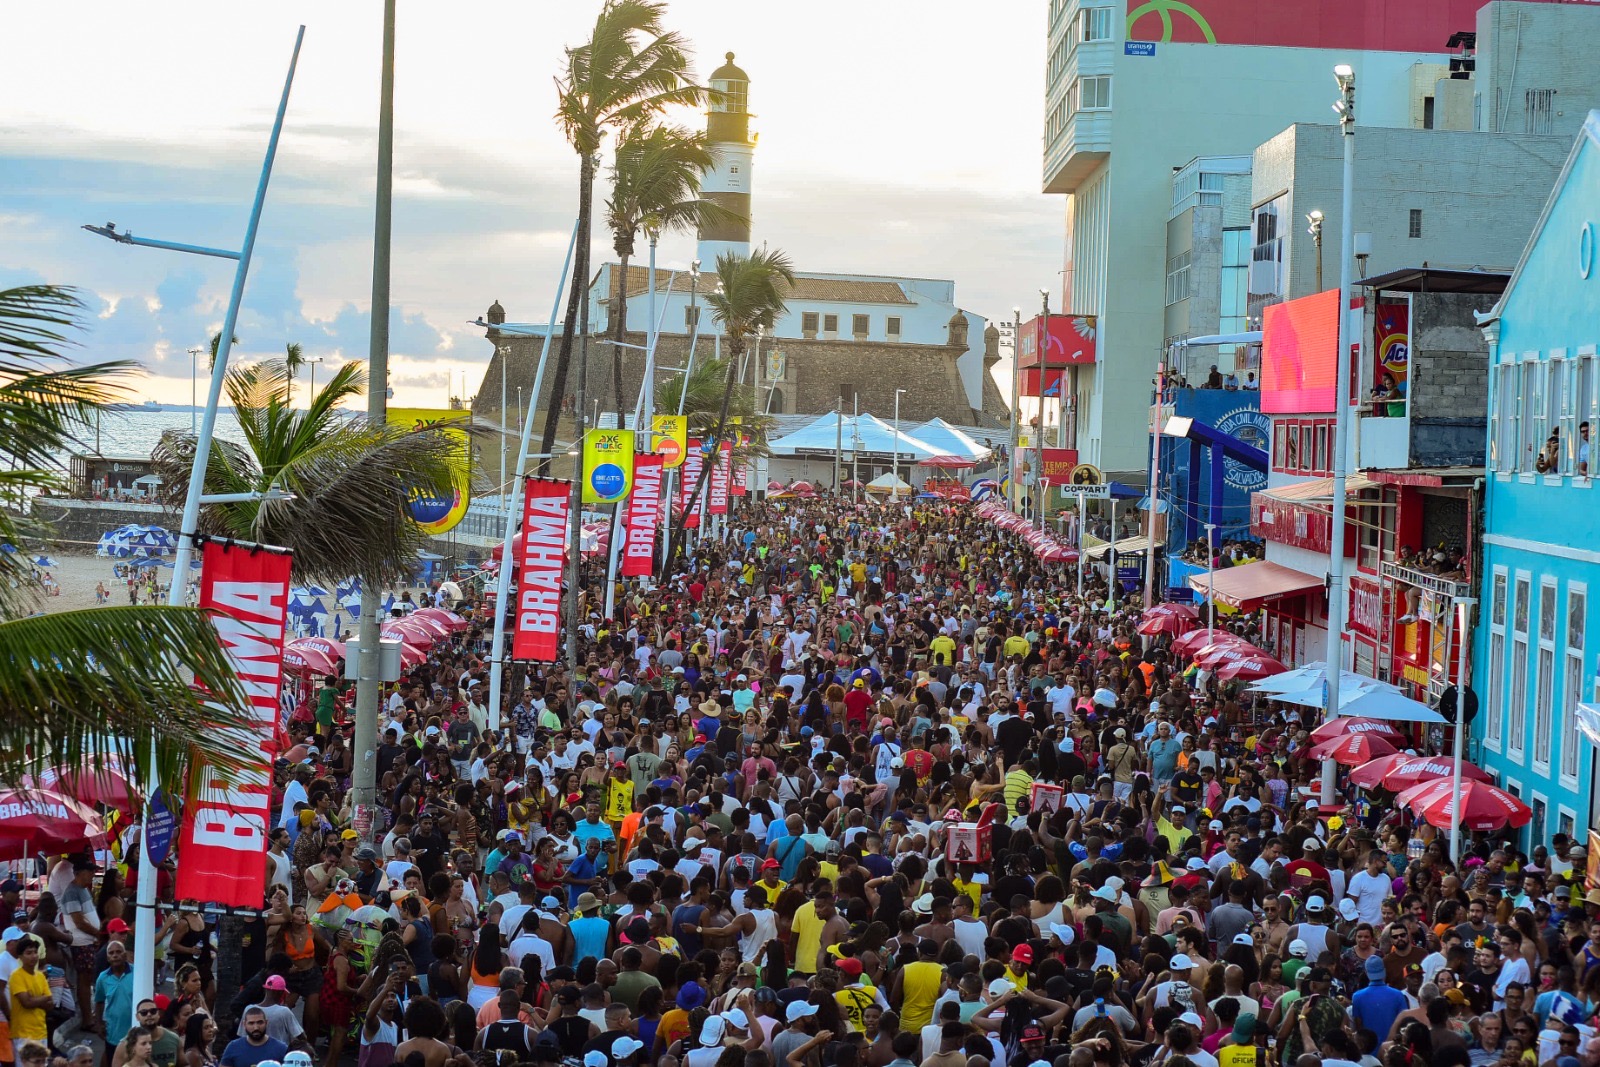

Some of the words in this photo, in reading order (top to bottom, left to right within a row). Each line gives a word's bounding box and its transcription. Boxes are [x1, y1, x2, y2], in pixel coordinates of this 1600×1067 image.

[711, 449, 730, 506] BRAHMA
[1225, 469, 1266, 485] SALVADOR
[1064, 485, 1107, 493] COPYART
[628, 464, 662, 558] BRAHMA
[519, 496, 567, 634] BRAHMA
[1347, 721, 1394, 735] BRAHMA
[1398, 761, 1451, 777] BRAHMA
[0, 800, 69, 820] BRAHMA
